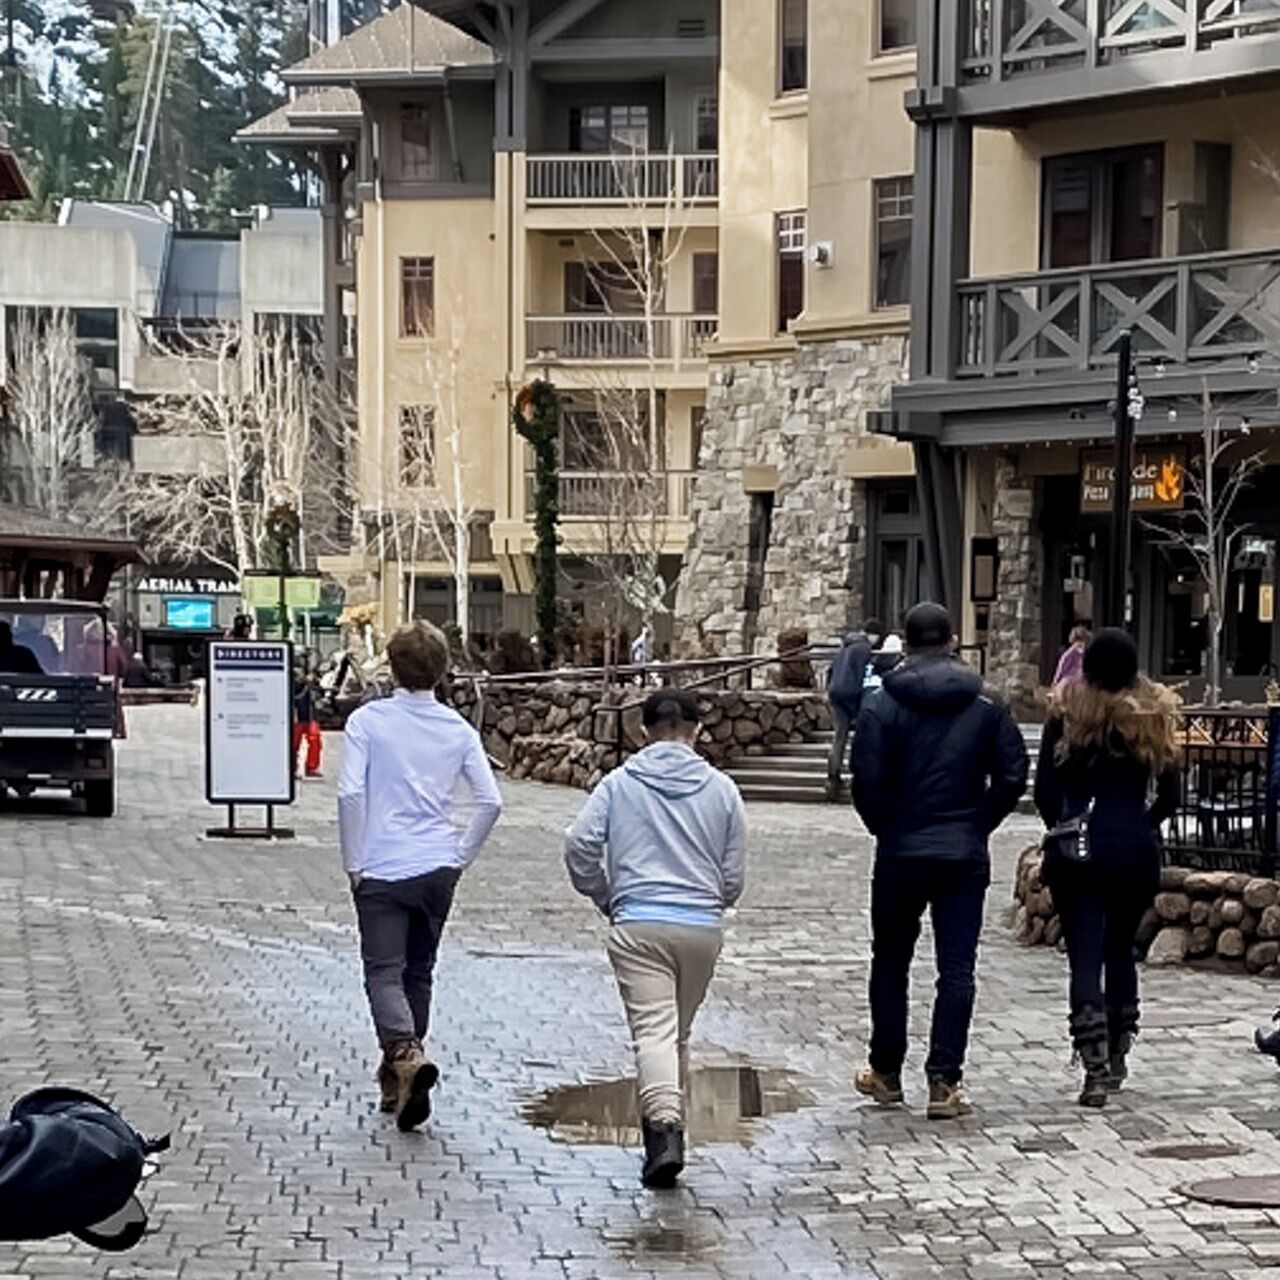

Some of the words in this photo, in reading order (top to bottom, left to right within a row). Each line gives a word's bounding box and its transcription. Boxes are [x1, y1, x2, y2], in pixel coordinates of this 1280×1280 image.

[138, 578, 194, 593] AERIAL
[197, 580, 241, 593] TRAM
[217, 649, 281, 660] DIRECTORY
